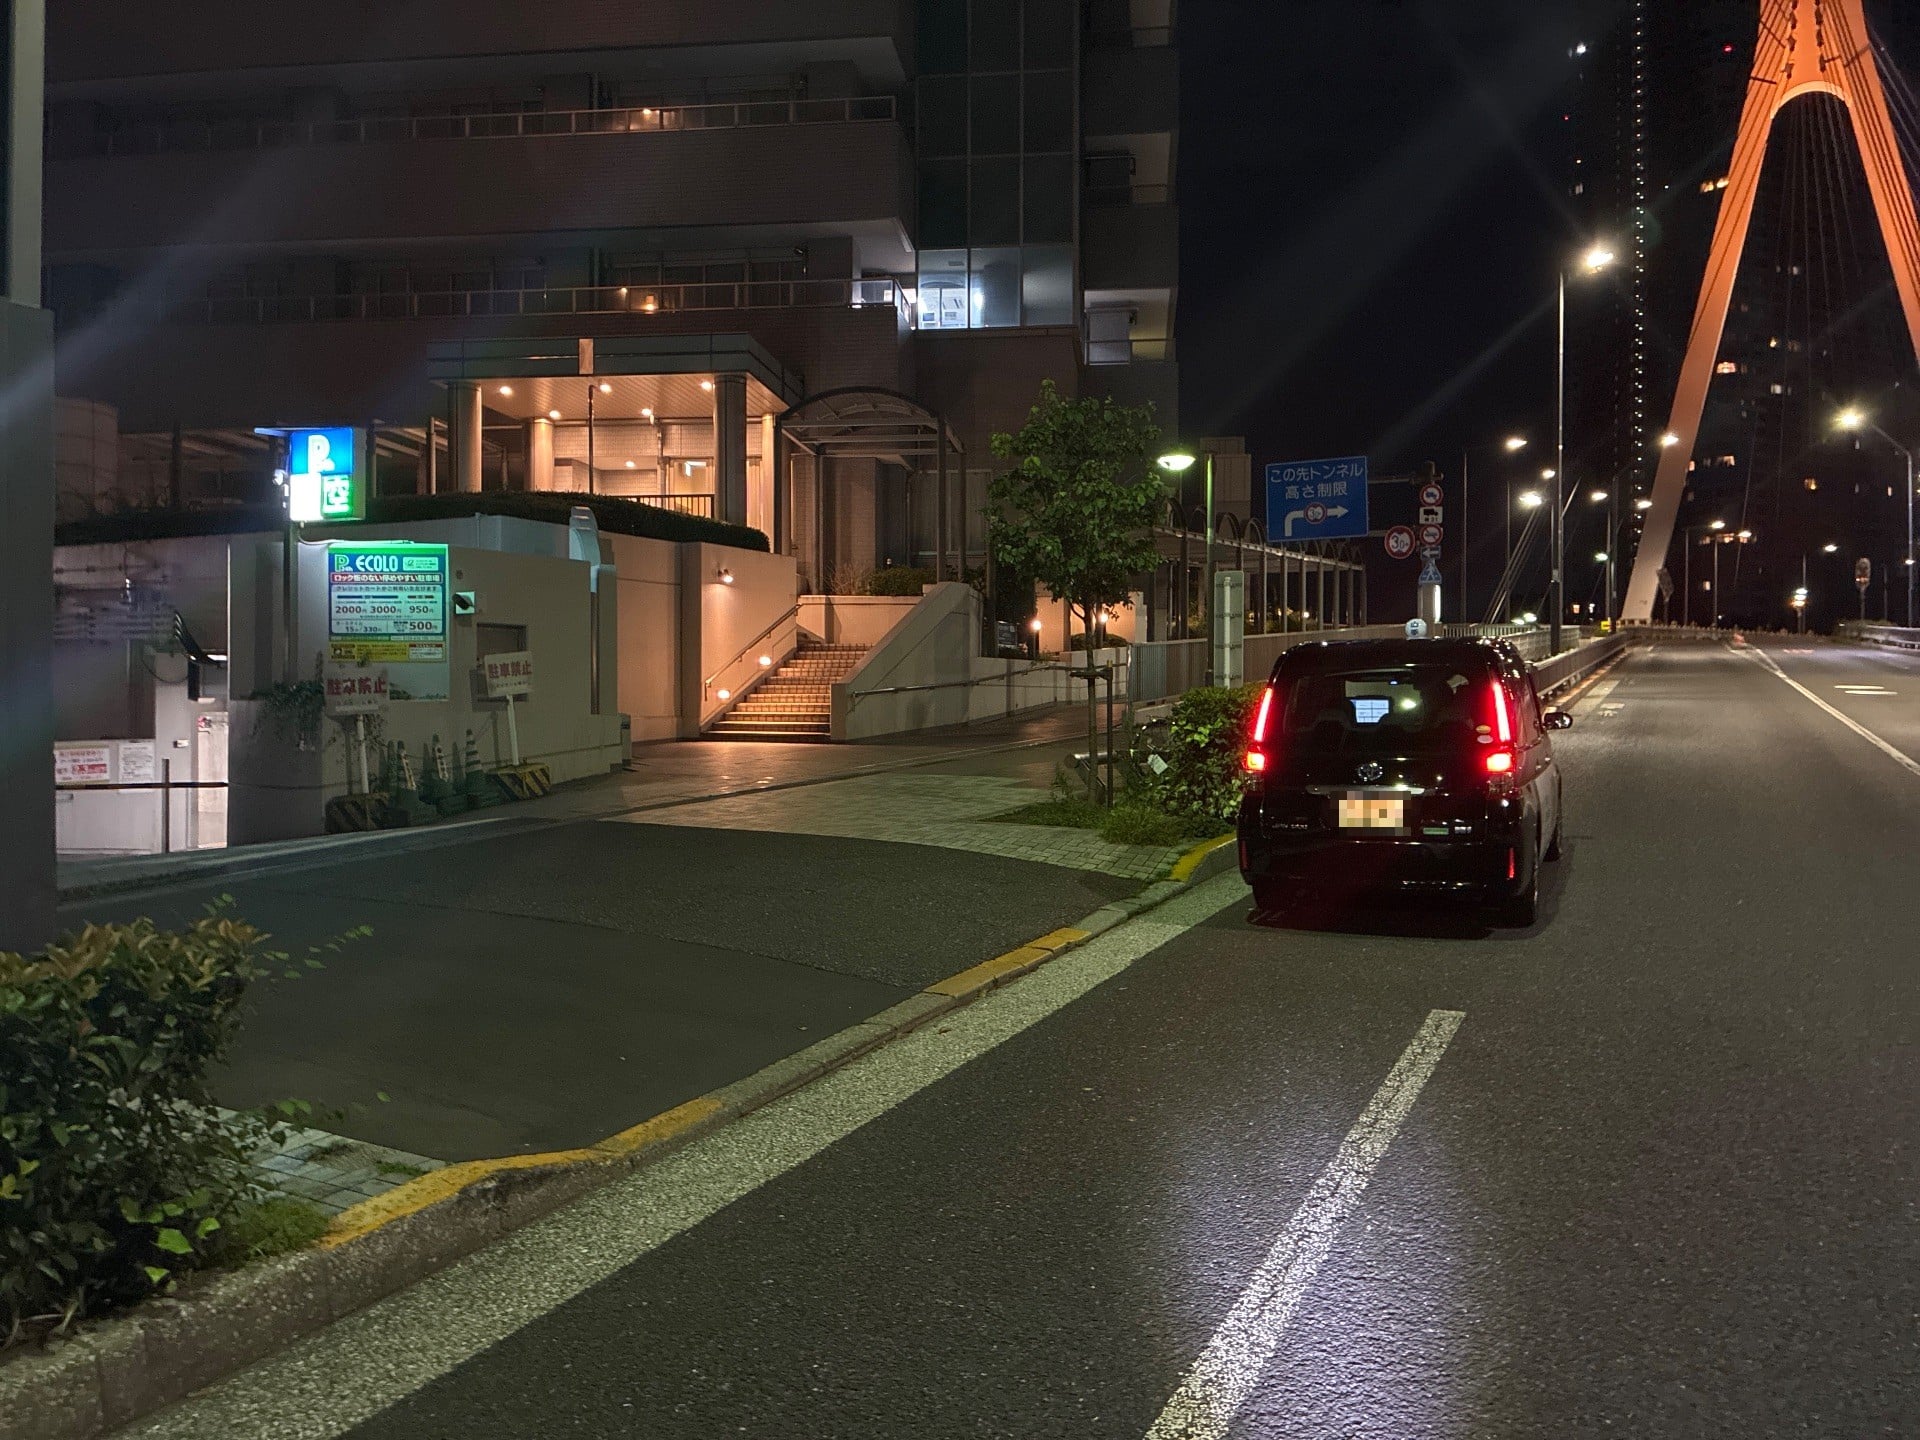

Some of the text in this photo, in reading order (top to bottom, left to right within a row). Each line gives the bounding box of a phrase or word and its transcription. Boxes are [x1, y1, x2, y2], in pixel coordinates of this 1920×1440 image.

[1270, 462, 1363, 482] この先トンネル
[1285, 481, 1348, 500] 高さ制限
[355, 554, 399, 572] ECOLO
[487, 660, 533, 679] 駐車禁止
[327, 676, 388, 696] 駐車禁止
